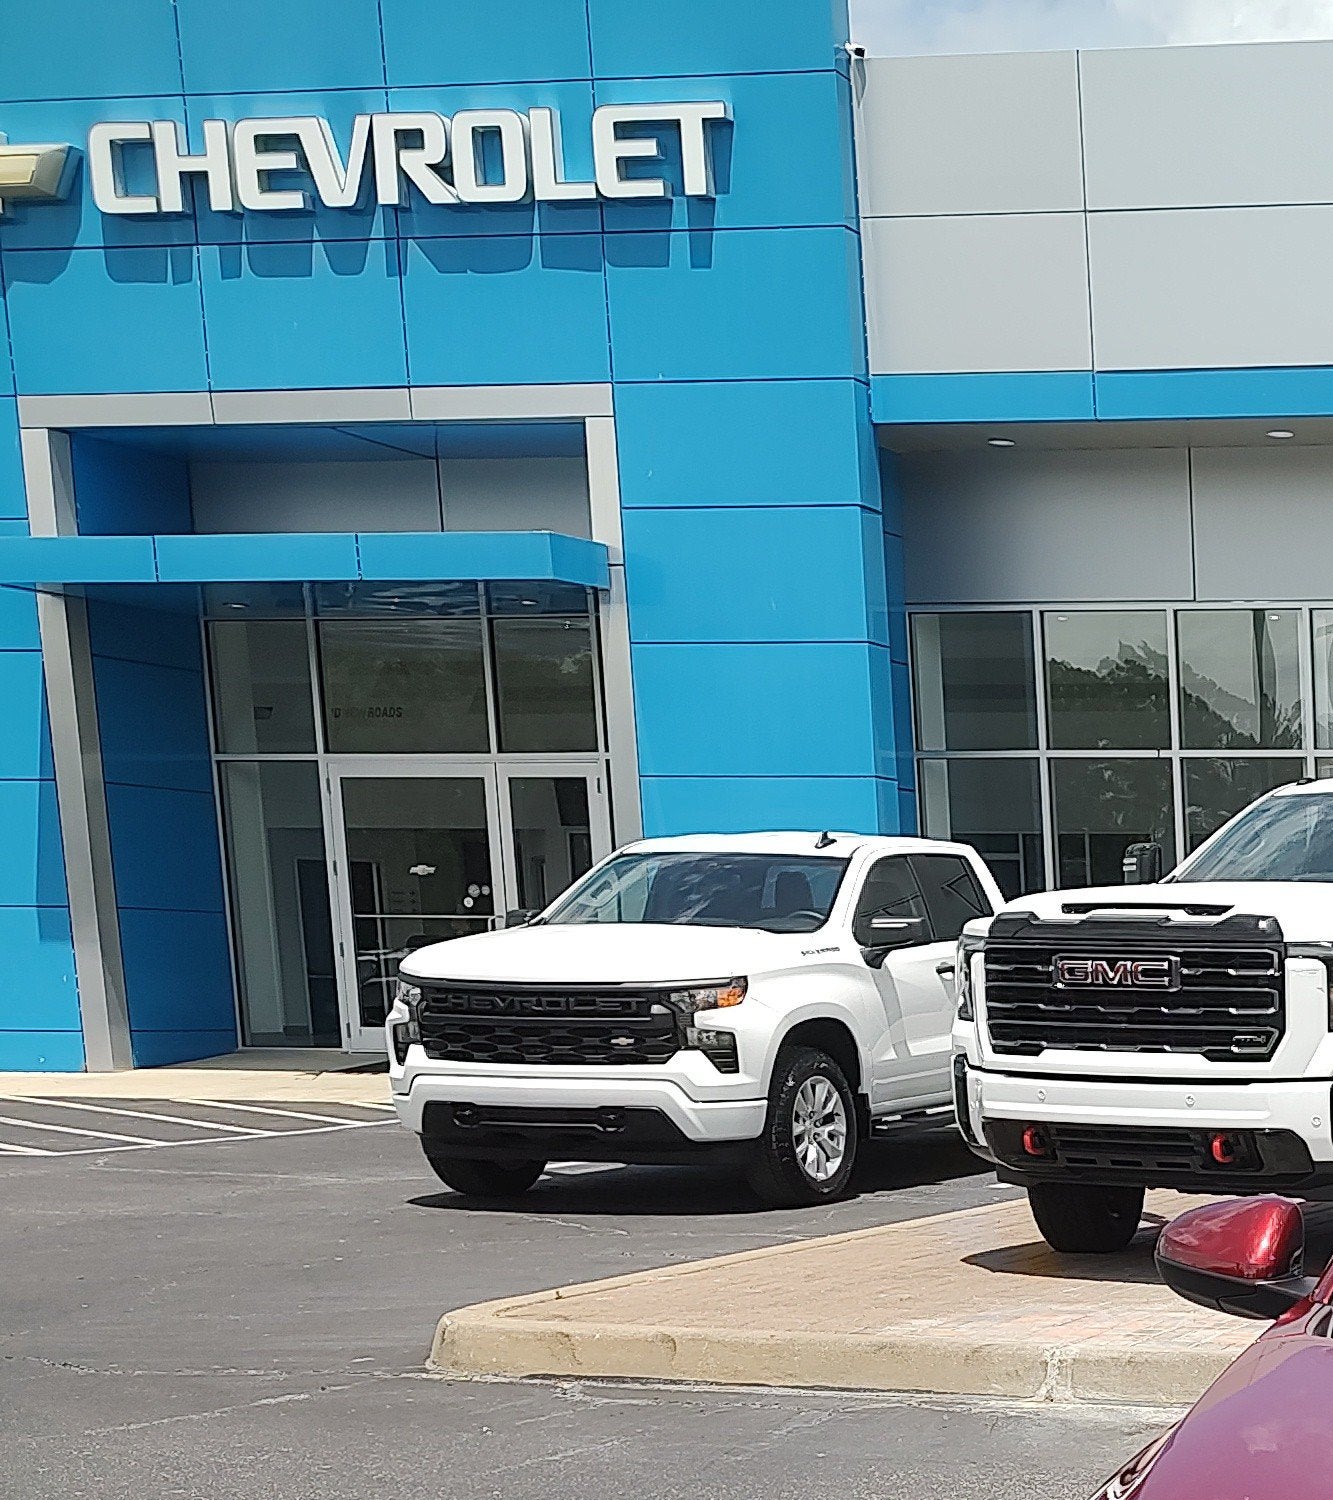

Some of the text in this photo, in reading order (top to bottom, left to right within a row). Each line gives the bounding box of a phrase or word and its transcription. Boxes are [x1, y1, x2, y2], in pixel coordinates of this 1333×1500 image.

[87, 100, 732, 214] CHEVROLET
[1057, 959, 1170, 986] GMC
[428, 994, 648, 1013] CHEVROLET
